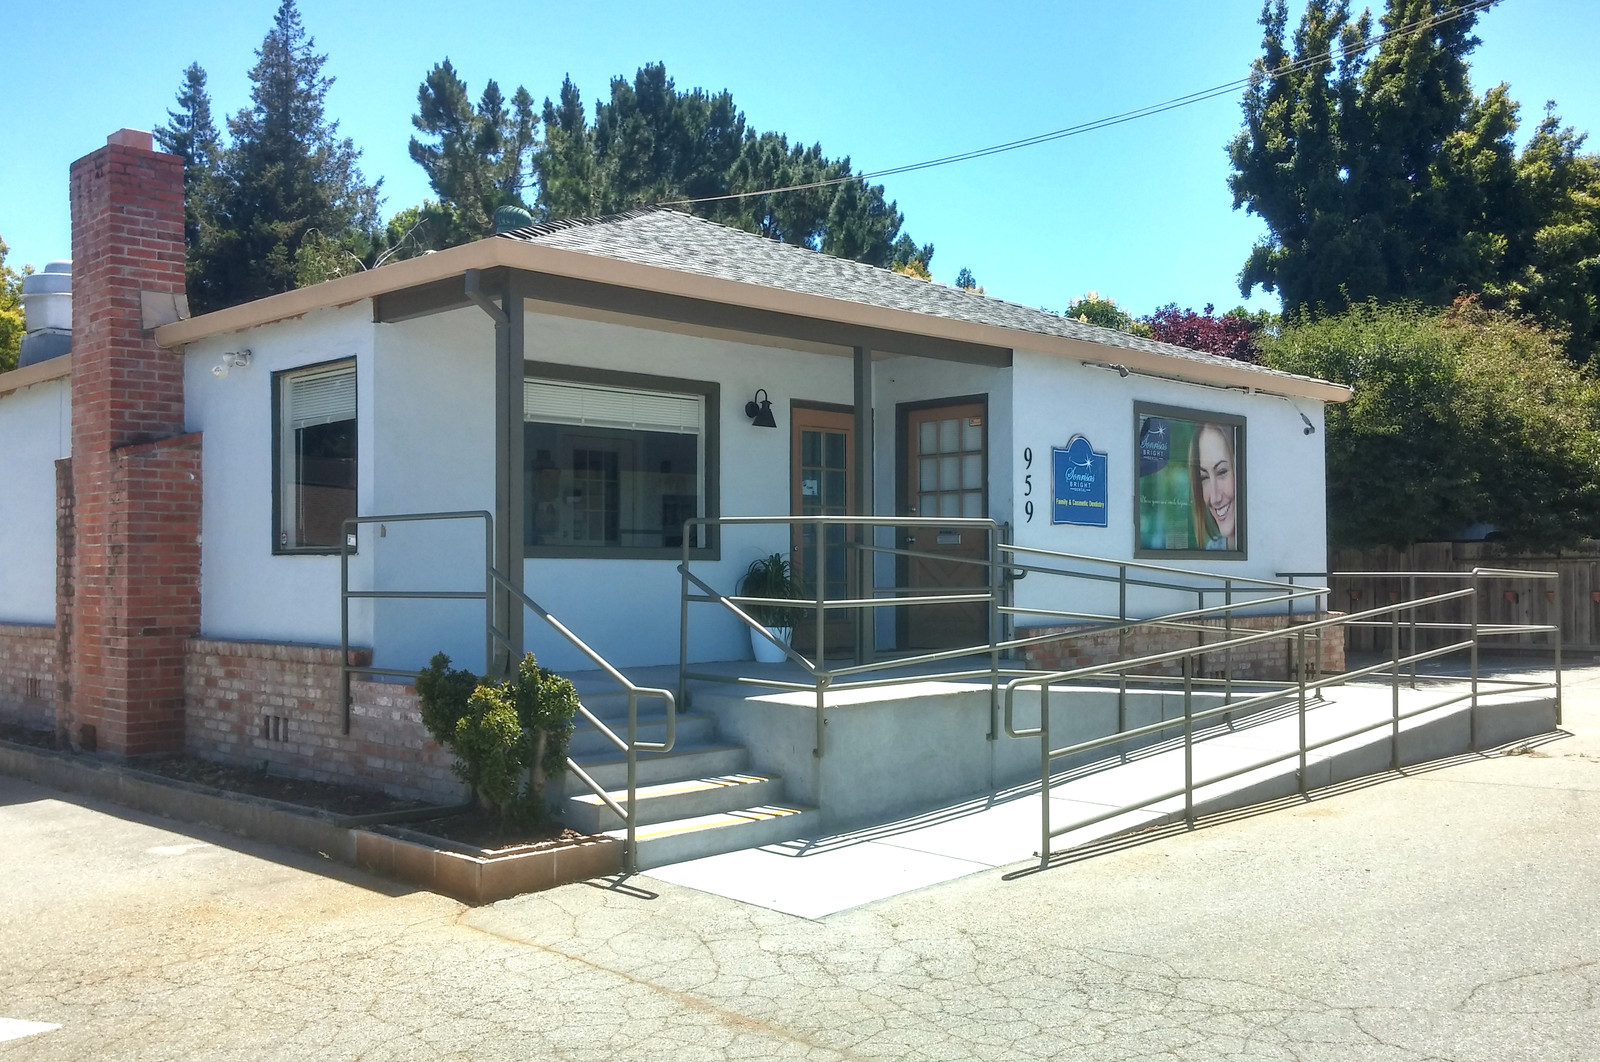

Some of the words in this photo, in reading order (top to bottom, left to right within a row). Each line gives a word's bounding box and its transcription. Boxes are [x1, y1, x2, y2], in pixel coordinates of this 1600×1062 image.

[1024, 447, 1034, 523] 959
[1056, 498, 1068, 506] Family
[1072, 499, 1089, 507] Cosmetic
[1089, 500, 1104, 509] Dentistry
